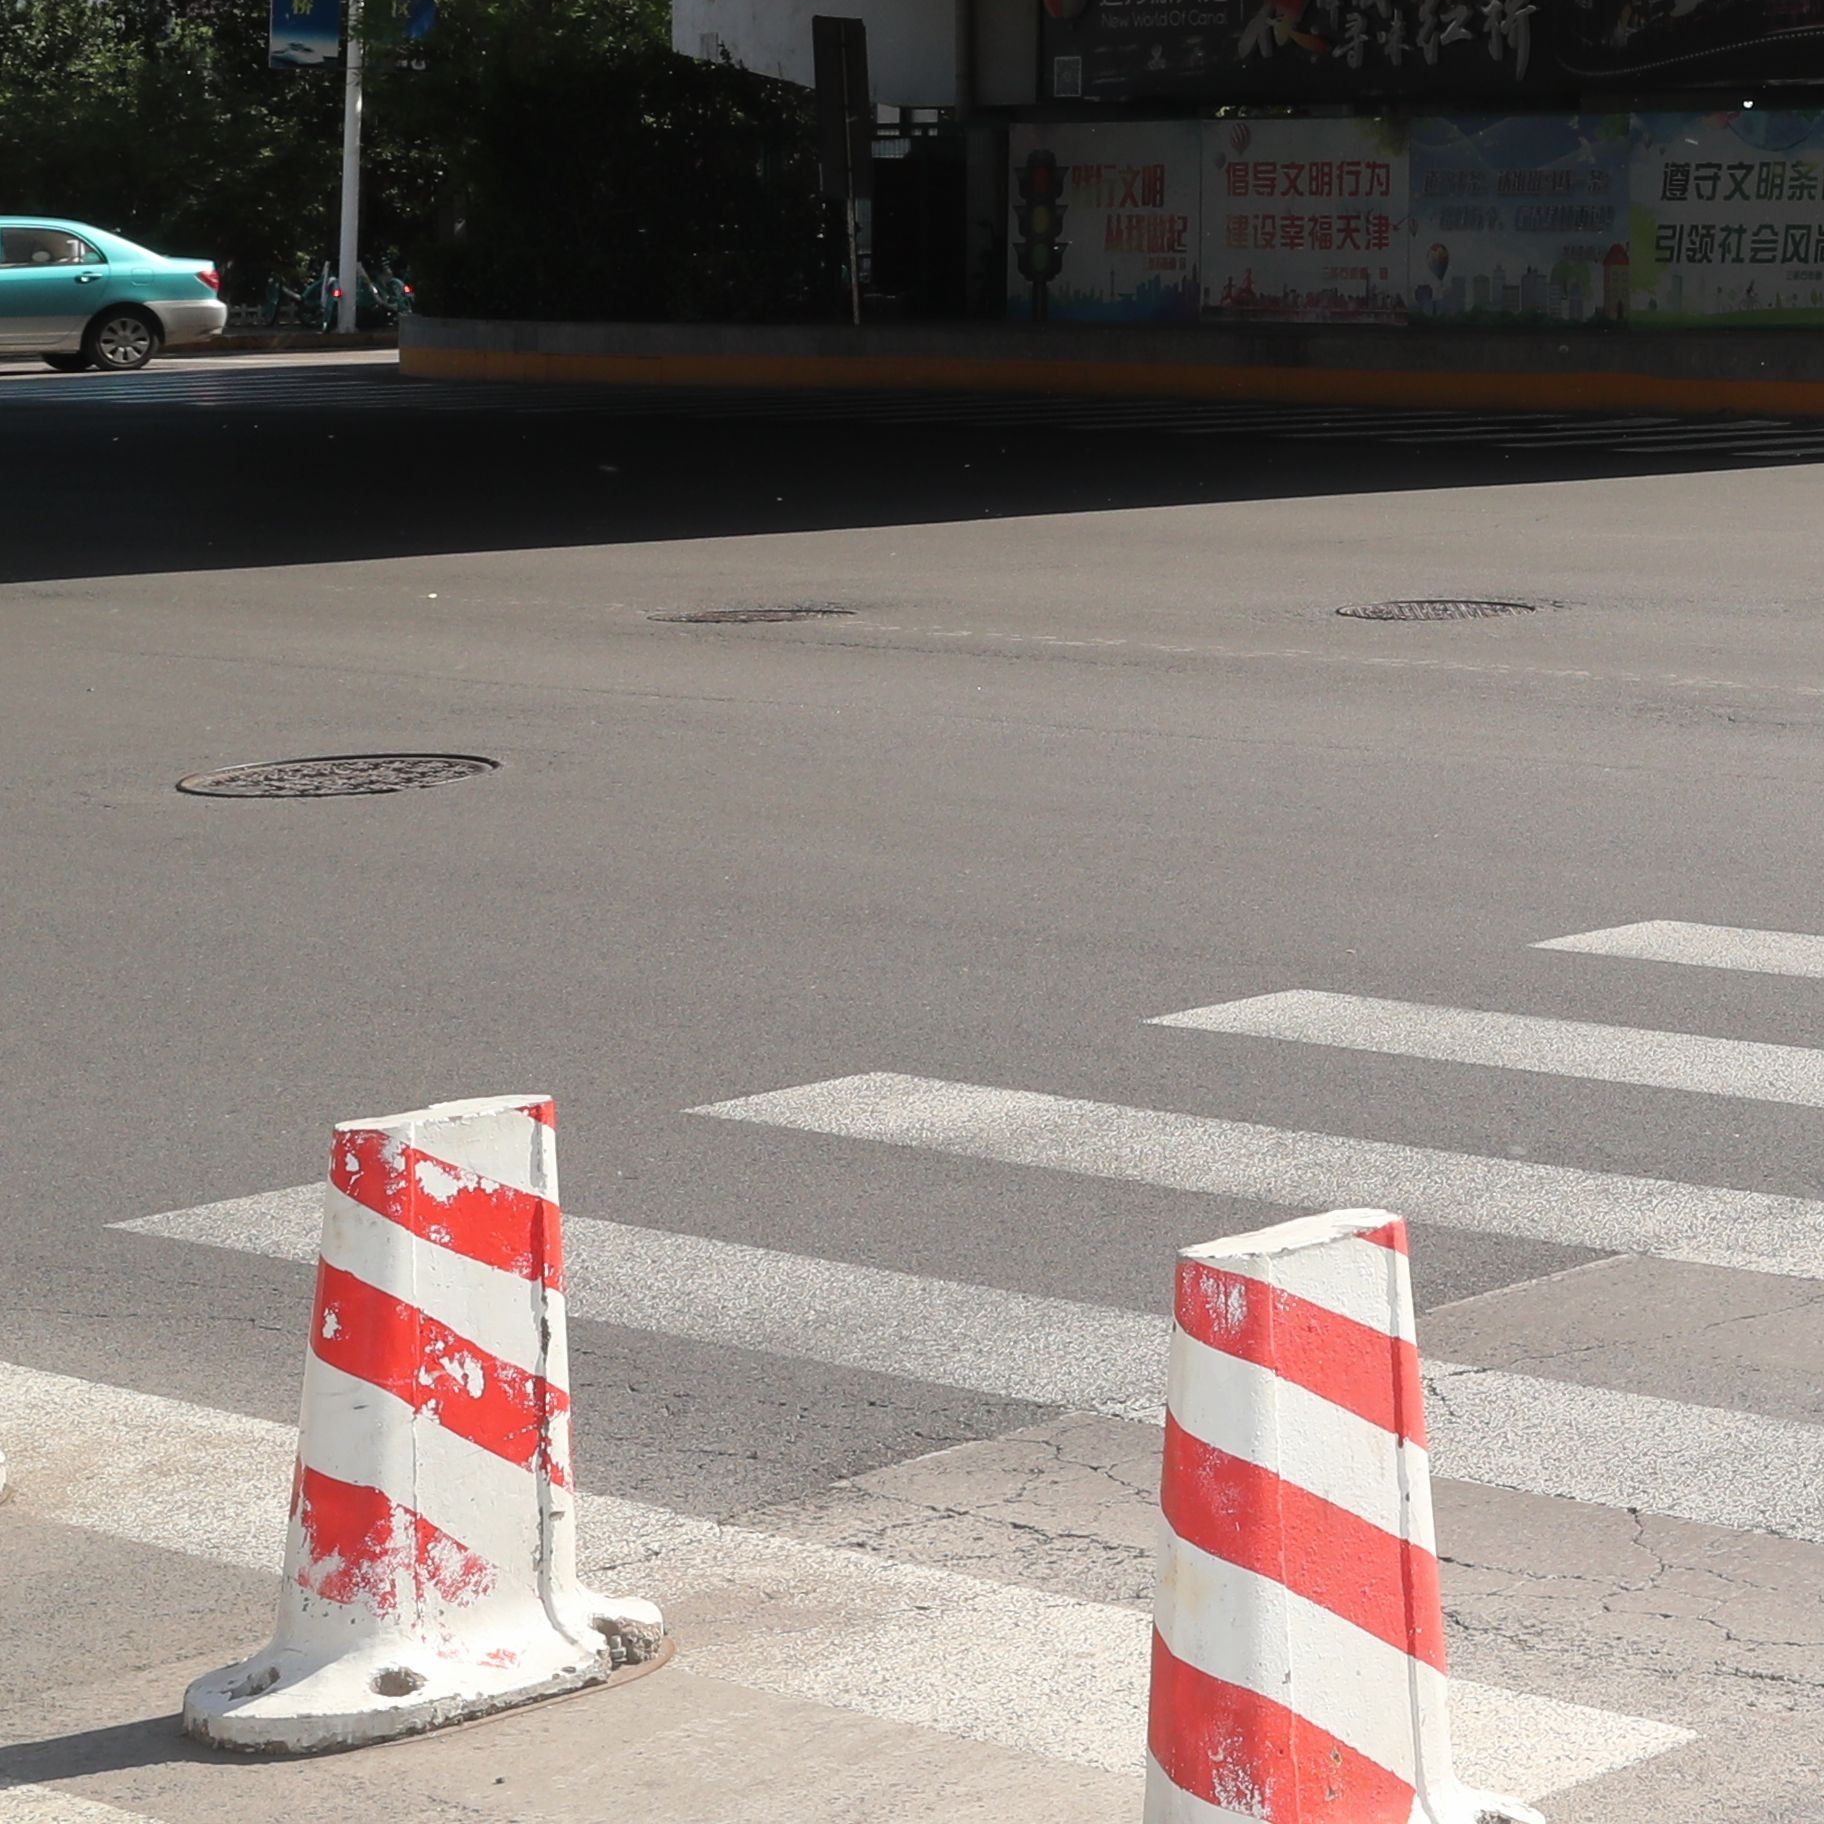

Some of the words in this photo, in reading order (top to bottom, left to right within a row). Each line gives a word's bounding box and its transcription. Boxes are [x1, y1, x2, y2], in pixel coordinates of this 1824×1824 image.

[1101, 12, 1129, 28] New
[1132, 9, 1168, 27] World
[1169, 9, 1186, 26] Of
[1225, 161, 1391, 197] 倡导文明行为
[1224, 215, 1391, 251] 建设幸福天津
